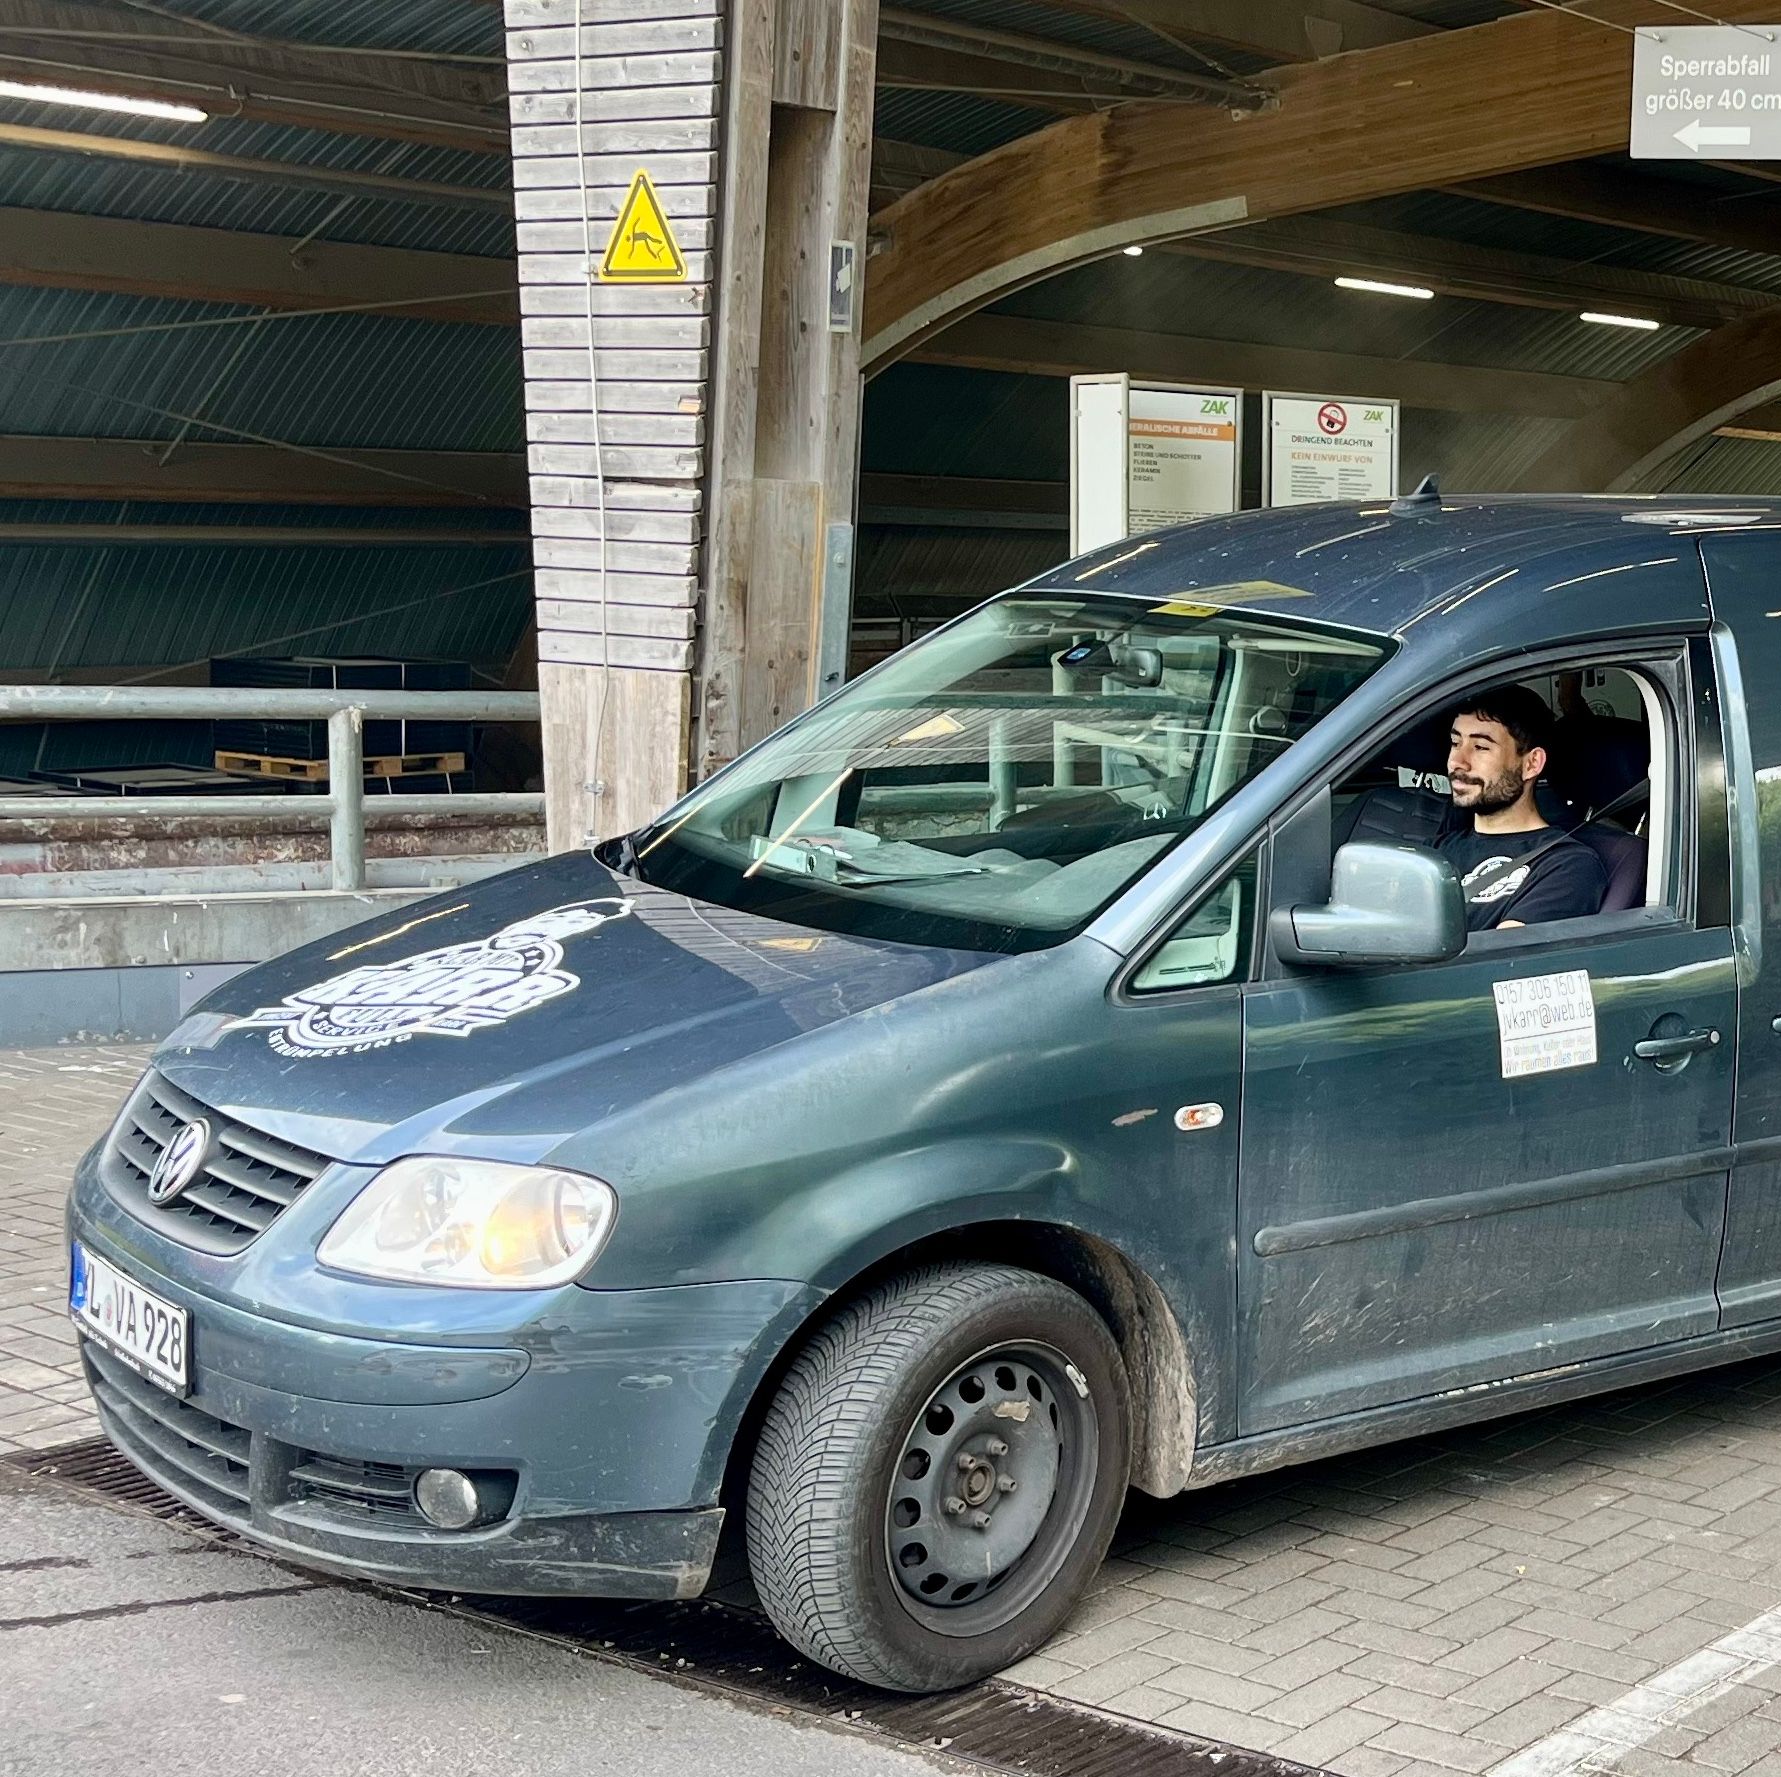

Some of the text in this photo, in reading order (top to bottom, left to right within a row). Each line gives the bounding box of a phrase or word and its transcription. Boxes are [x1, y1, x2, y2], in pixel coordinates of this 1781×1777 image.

[1660, 55, 1770, 79] Sperrabfall
[1645, 90, 1713, 112] größer
[1717, 89, 1746, 110] 40
[1200, 400, 1229, 414] ZAK
[1364, 410, 1384, 421] ZAK
[1291, 435, 1373, 448] DRINGEND BEACHTEN
[1291, 452, 1373, 464] KEIN EINWURF VON
[1496, 973, 1590, 1005] 0157 306 150 11
[114, 1279, 137, 1348] VA
[144, 1300, 183, 1374] 928
